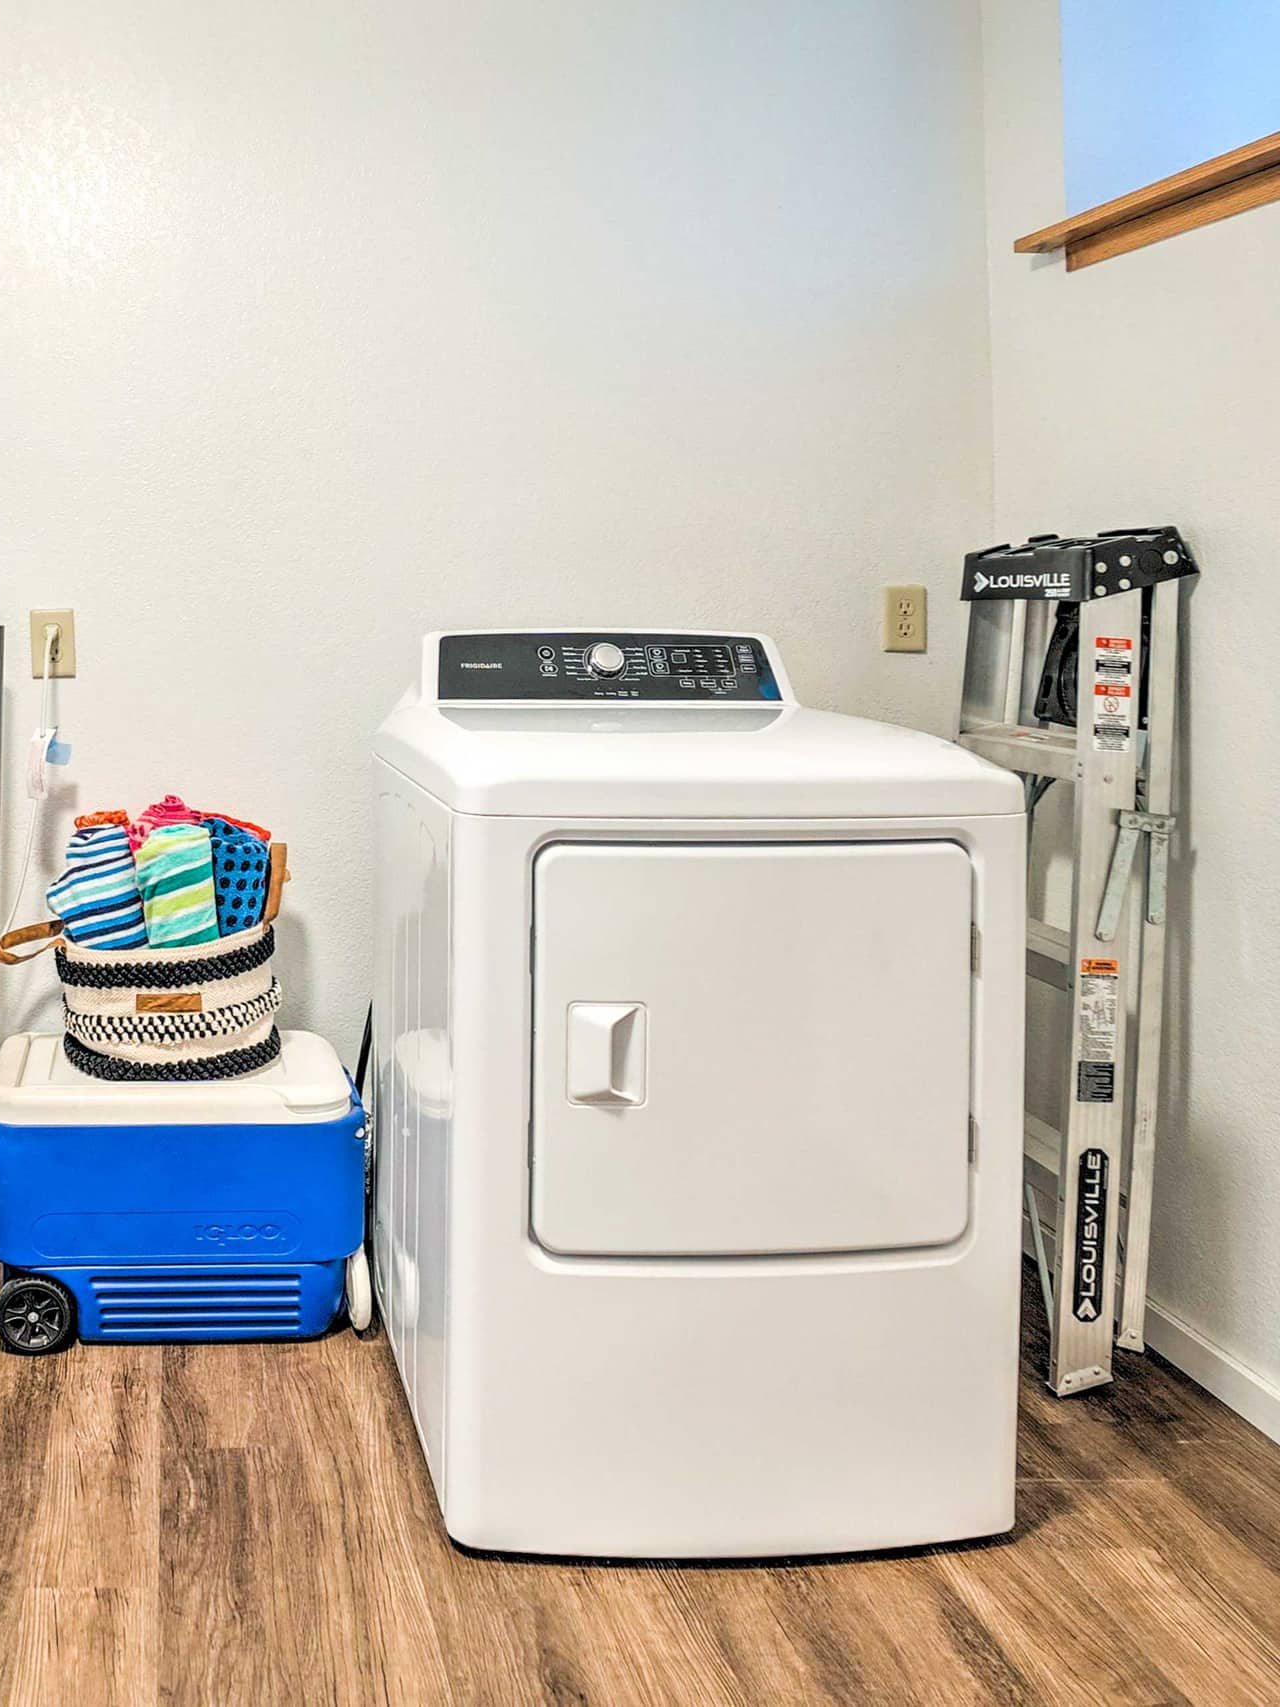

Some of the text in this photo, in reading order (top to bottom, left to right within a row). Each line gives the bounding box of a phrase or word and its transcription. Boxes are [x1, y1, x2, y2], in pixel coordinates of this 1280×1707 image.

[990, 573, 1071, 588] LOUISVILLE
[193, 1224, 281, 1245] IGLOO
[1080, 1152, 1102, 1296] LOUISVILLE
